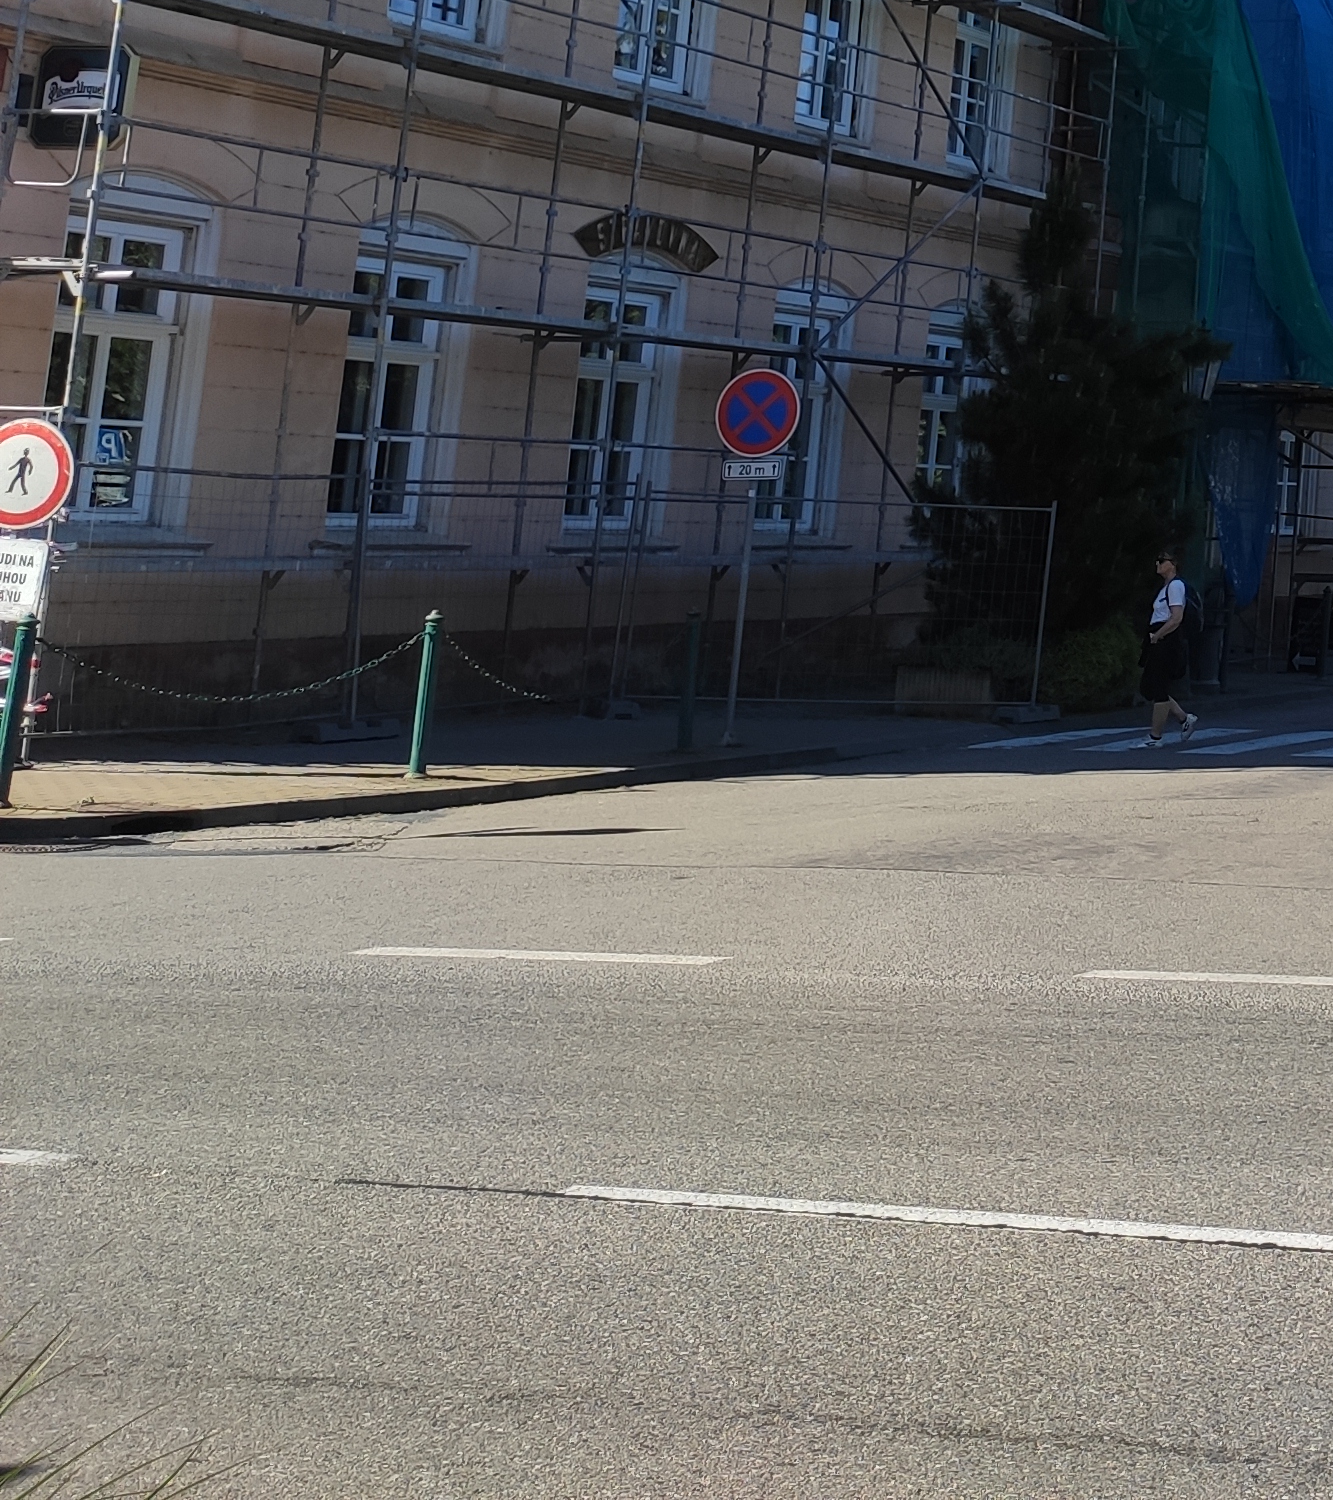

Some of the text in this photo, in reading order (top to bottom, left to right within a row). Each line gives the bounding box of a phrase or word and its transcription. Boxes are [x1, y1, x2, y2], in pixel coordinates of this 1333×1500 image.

[48, 79, 106, 105] Pilsner Urquel
[739, 464, 765, 476] 20 m
[19, 554, 34, 569] NA
